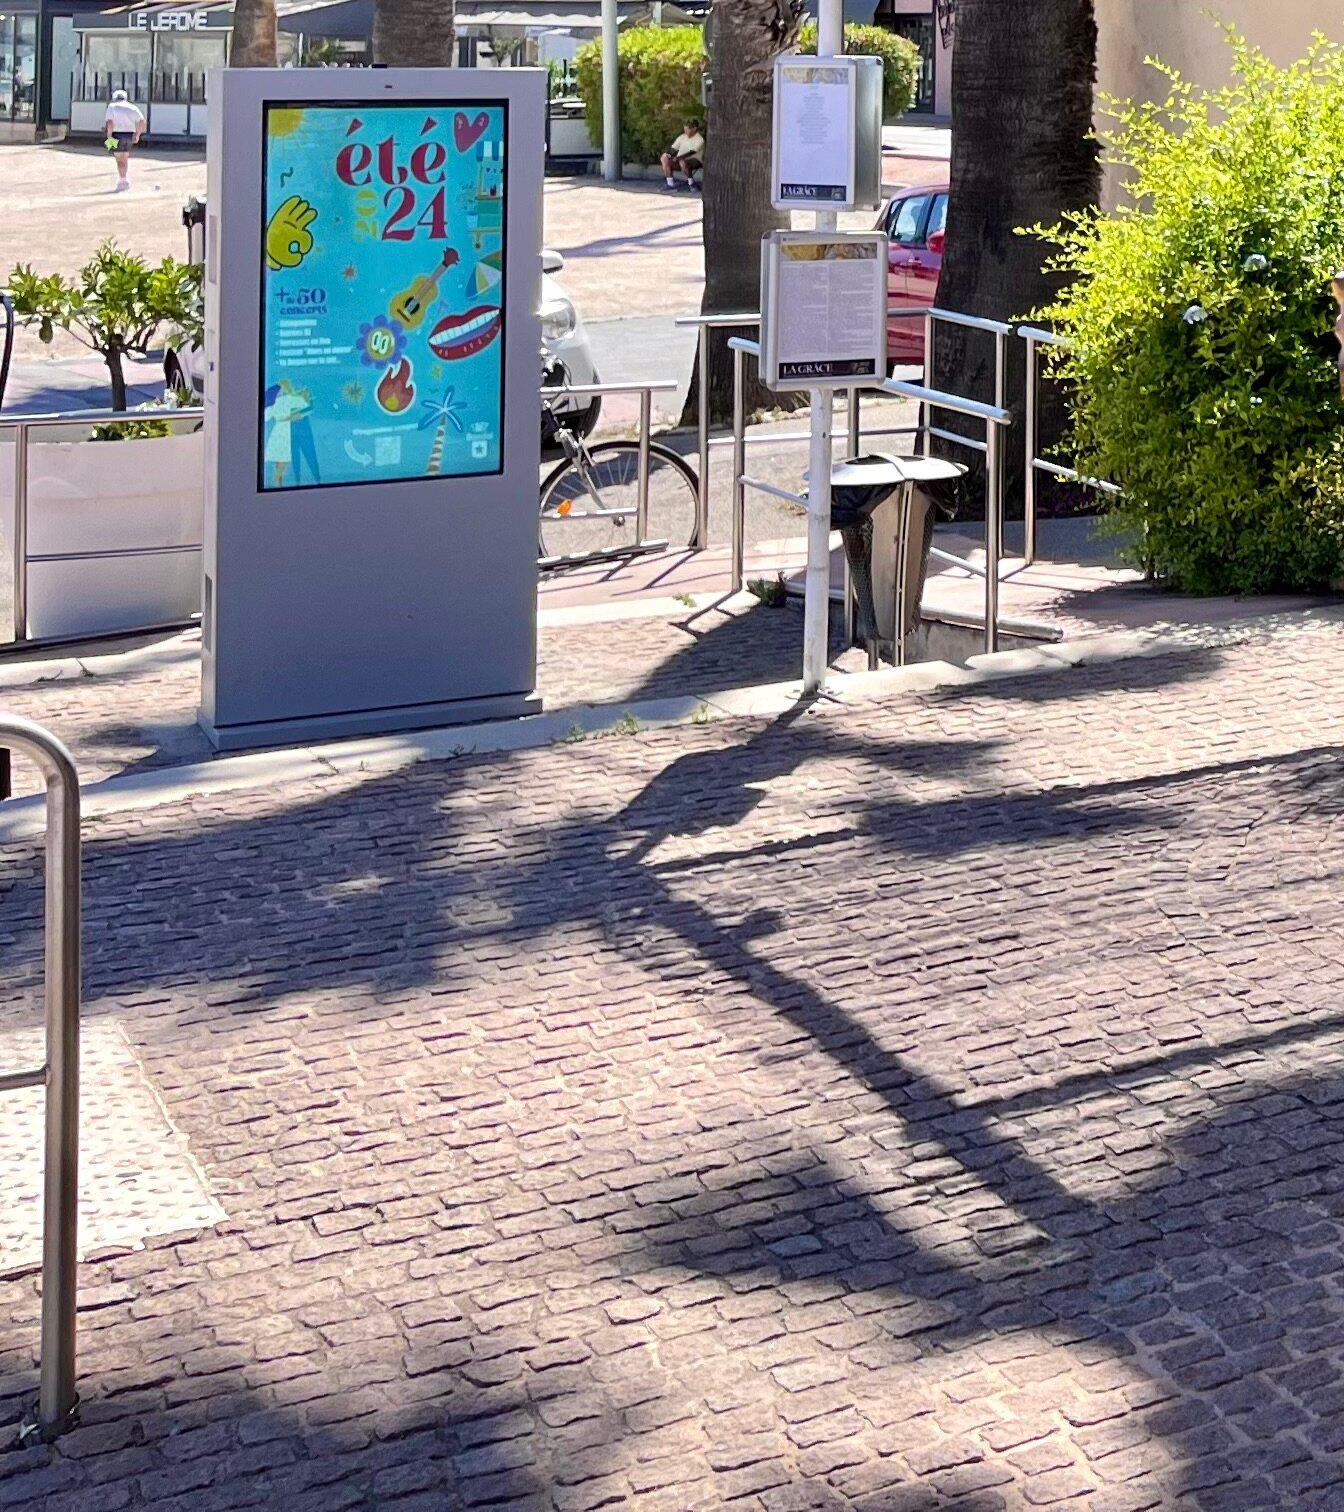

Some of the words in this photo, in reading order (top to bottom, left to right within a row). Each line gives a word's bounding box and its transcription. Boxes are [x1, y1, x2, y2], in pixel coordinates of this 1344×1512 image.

[128, 12, 147, 30] LE
[336, 116, 447, 186] été
[381, 186, 448, 240] 24
[297, 288, 326, 305] 50
